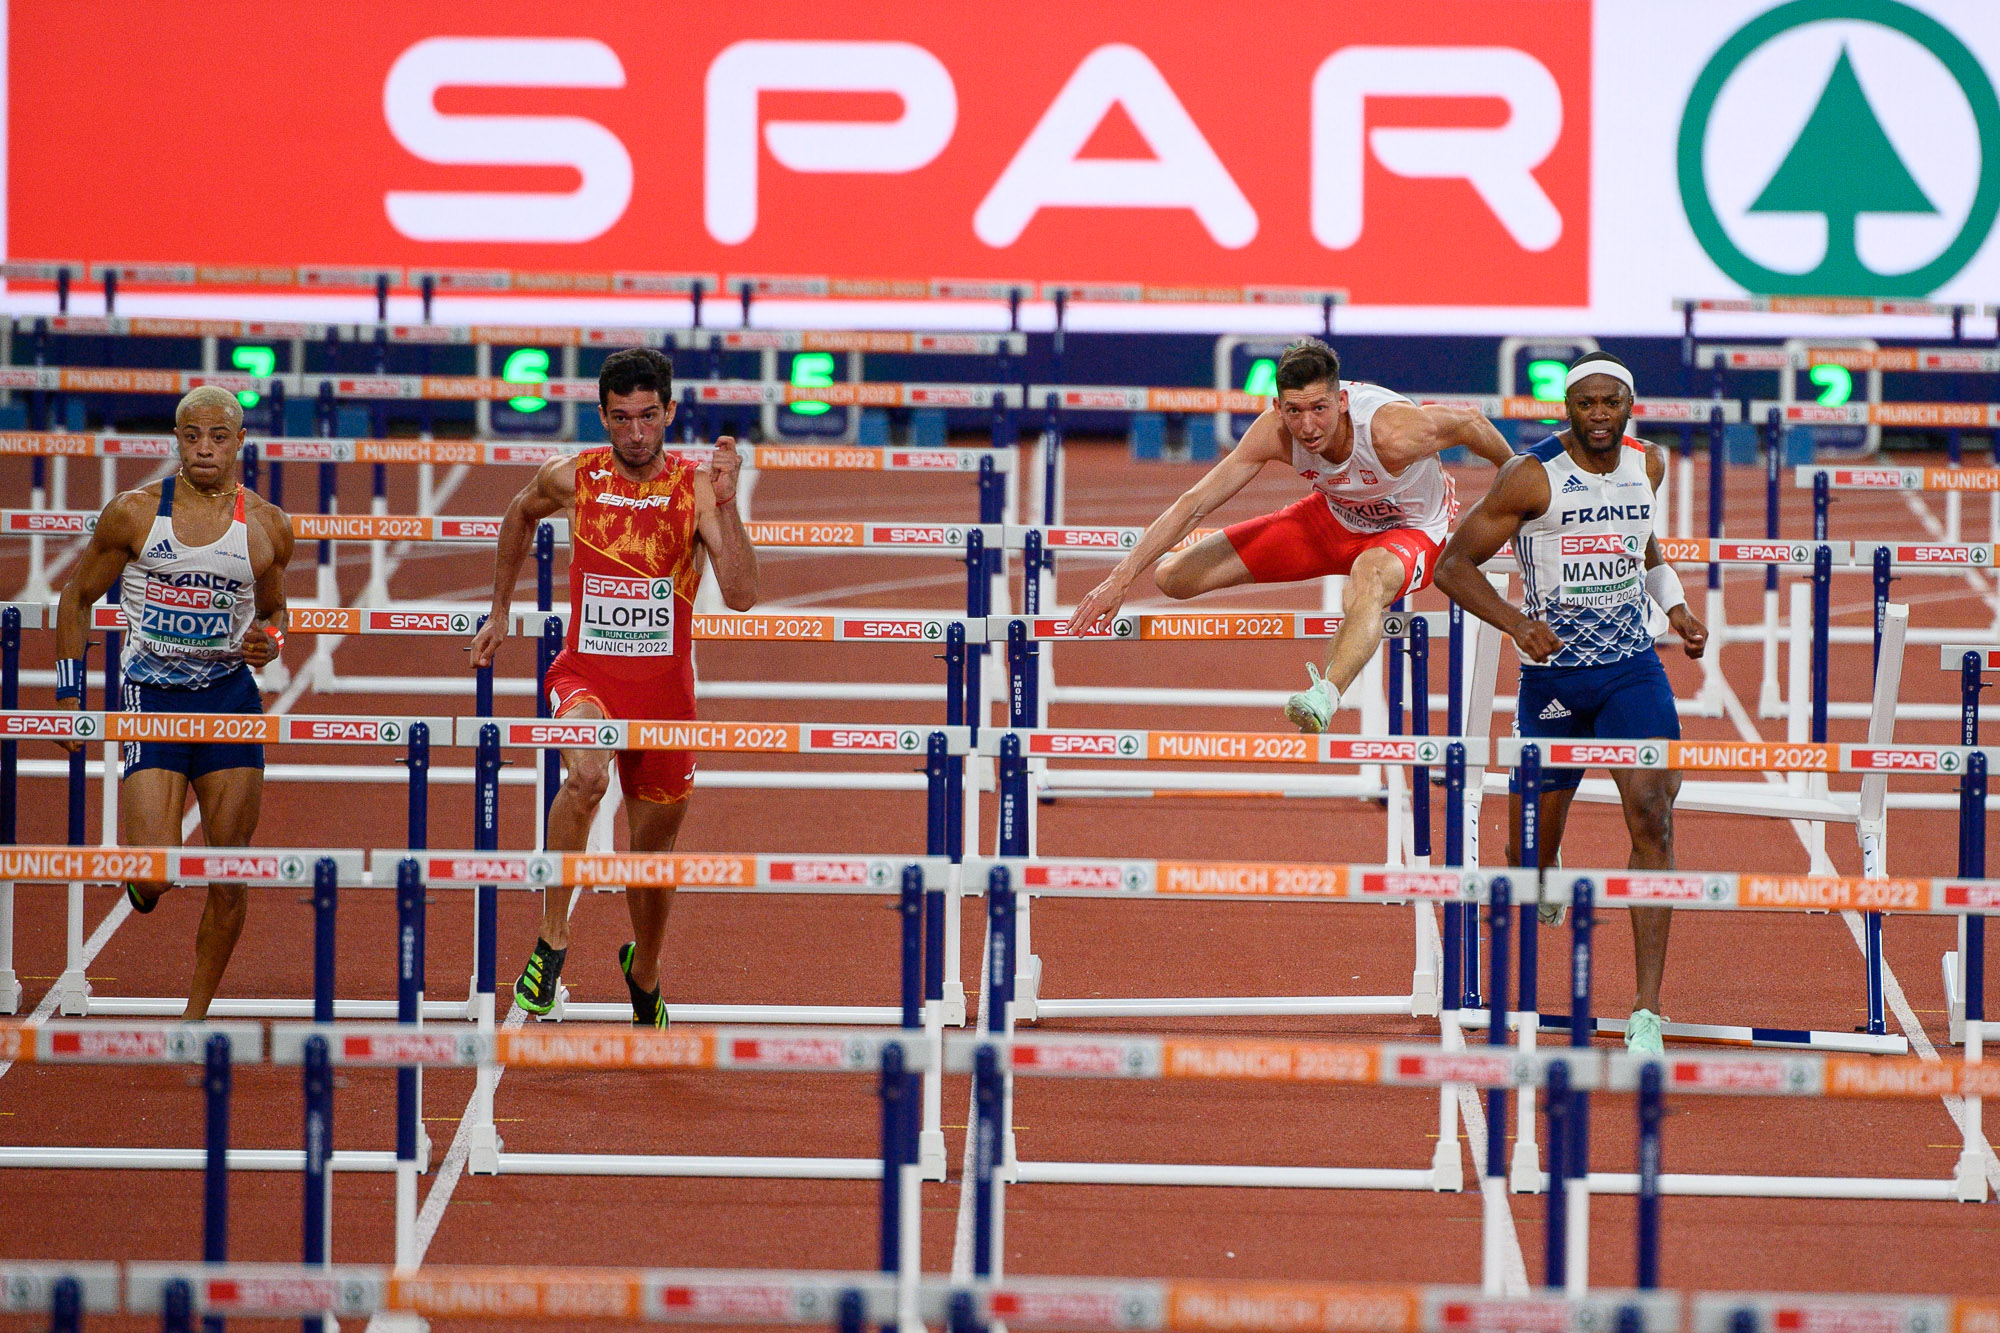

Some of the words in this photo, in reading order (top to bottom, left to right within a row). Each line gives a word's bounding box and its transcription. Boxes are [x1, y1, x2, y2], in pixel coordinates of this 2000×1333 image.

[383, 36, 1565, 250] SPAR
[0, 437, 40, 452] NICH
[45, 438, 87, 454] 2022
[363, 443, 430, 461] MUNICH
[435, 445, 477, 463] 2022
[762, 450, 829, 466] MUNICH
[834, 451, 876, 467] 2022
[1932, 472, 1999, 488] MUNICH
[1561, 484, 1589, 494] adidas
[595, 492, 671, 510] ESPAÑA
[28, 517, 83, 530] SPAR
[1561, 504, 1651, 526] FRANCE
[301, 519, 372, 535] MUNICH
[379, 521, 422, 537] 2022
[459, 523, 501, 537] SPA
[748, 526, 804, 542] UNICH
[811, 527, 854, 543] 2022
[890, 529, 943, 542] SPAR
[1066, 532, 1118, 545] SPAR
[1563, 537, 1625, 553] SPAR
[147, 551, 178, 560] adidas
[1659, 543, 1700, 560] 2022
[1736, 546, 1790, 559] SPAR
[1915, 548, 1968, 561] SPAR
[1562, 557, 1638, 582] MANGA
[147, 585, 210, 606] SPAR
[586, 578, 648, 598] SPAR
[1585, 585, 1603, 593] RUN
[1605, 582, 1627, 592] CLEAN
[1566, 594, 1613, 607] MUNICH
[1616, 587, 1638, 603] 2022
[141, 609, 229, 635] ZHOYA
[301, 612, 349, 629] 2022
[389, 614, 448, 629] SPAR
[584, 603, 670, 628] LLOPIS
[624, 632, 650, 640] CLEAN
[691, 619, 768, 636] MUNICH
[776, 620, 823, 637] 2022
[863, 622, 922, 636] SPAR
[1151, 619, 1229, 635] MUNICH
[1236, 620, 1283, 636] 2022
[584, 639, 634, 653] MUNICH
[637, 641, 668, 653] 2022
[1013, 680, 1022, 716] MONDO
[1539, 708, 1572, 720] adidas
[6, 717, 72, 733] SPAR
[117, 717, 205, 738] MUNICH
[212, 720, 267, 739] 2022
[312, 723, 378, 740] SPAR
[1966, 710, 1974, 746] MONDO
[531, 727, 596, 743] SPAR
[640, 727, 727, 746] MUNICH
[733, 729, 788, 749] 2022
[832, 731, 896, 746] SPAR
[1050, 736, 1116, 752] SPAR
[1158, 736, 1246, 756] MUNICH
[1252, 738, 1307, 759] 2022
[1350, 742, 1415, 758] SPAR
[1571, 746, 1636, 762] SPAR
[1678, 746, 1766, 767] MUNICH
[1773, 748, 1827, 769] 2022
[1872, 752, 1936, 768] SPAR
[484, 790, 494, 829] MONDO
[1003, 800, 1014, 840] MONDO
[91, 854, 153, 879] 2022
[203, 856, 278, 877] SPAR
[574, 860, 675, 882] MUNICH
[681, 861, 744, 884] 2022
[1168, 868, 1268, 891] MUNICH
[1273, 870, 1337, 895] 2022
[1750, 880, 1850, 902] MUNICH
[1856, 882, 1919, 907] 2022
